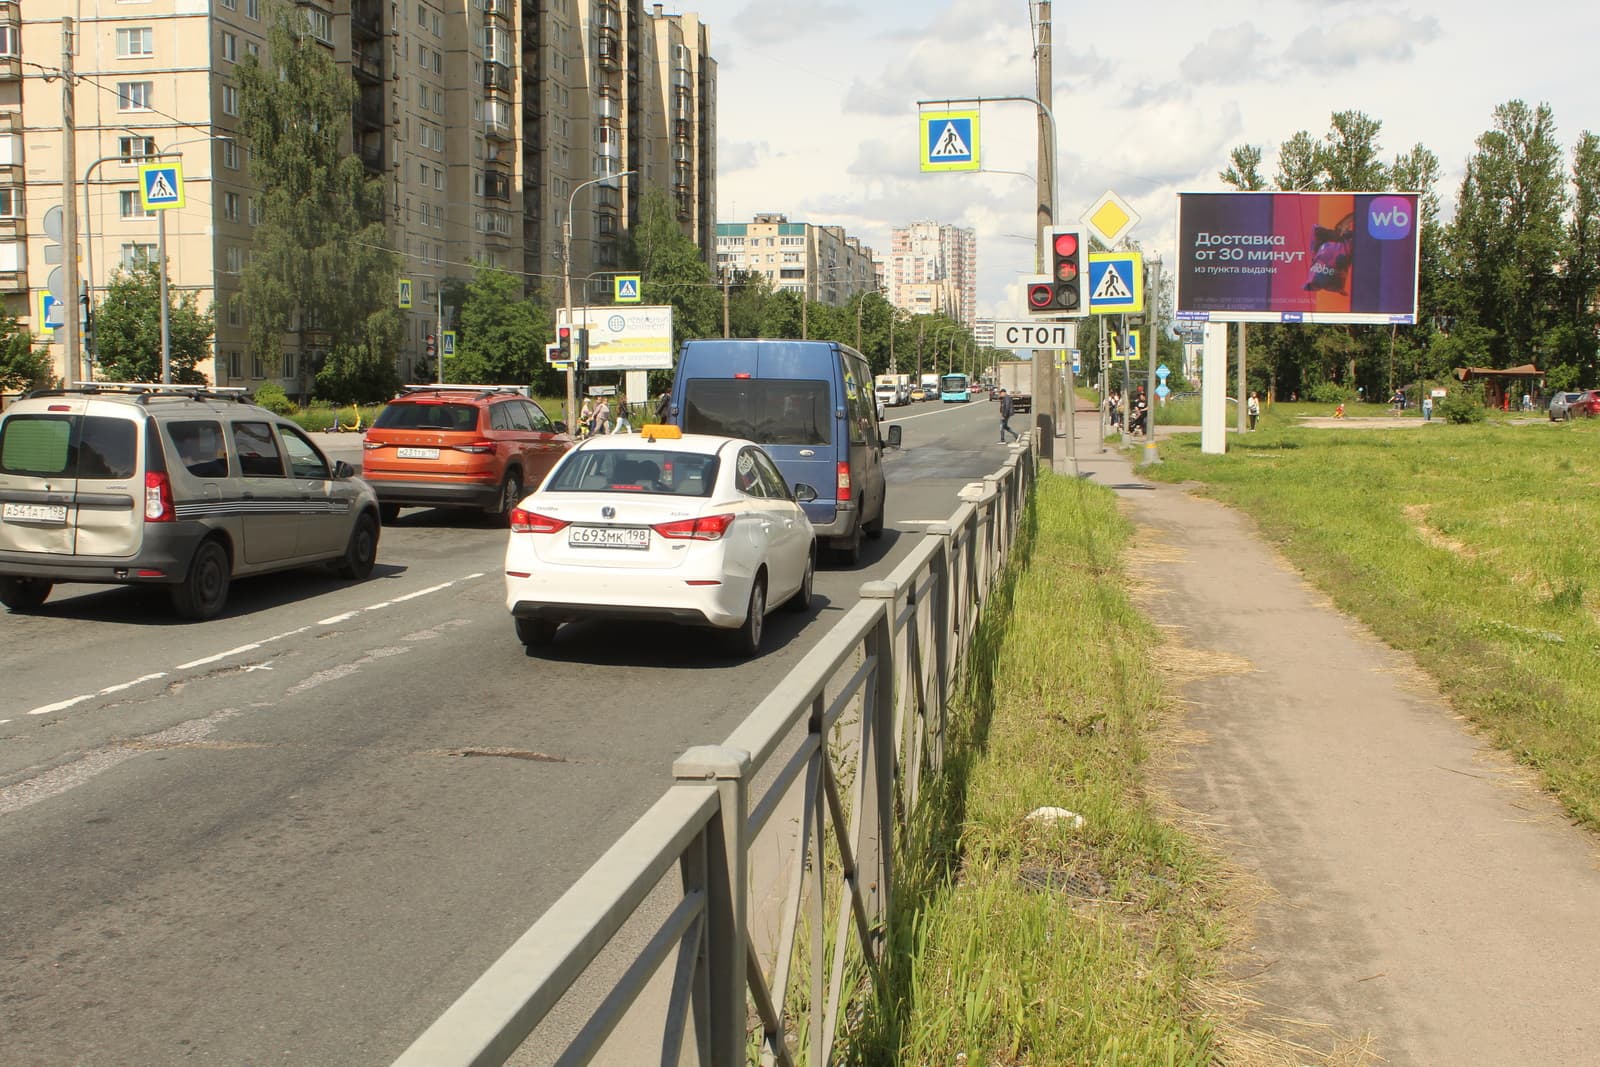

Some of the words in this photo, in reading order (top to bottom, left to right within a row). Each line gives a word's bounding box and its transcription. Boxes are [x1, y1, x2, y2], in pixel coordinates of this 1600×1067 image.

[1371, 205, 1409, 227] wb
[1195, 232, 1286, 247] Доставка
[1195, 250, 1216, 261] от
[1219, 248, 1244, 261] 30
[1247, 251, 1305, 263] минут
[1207, 266, 1240, 275] пункта
[1241, 266, 1278, 275] выдачи
[1006, 326, 1066, 344] СТОП
